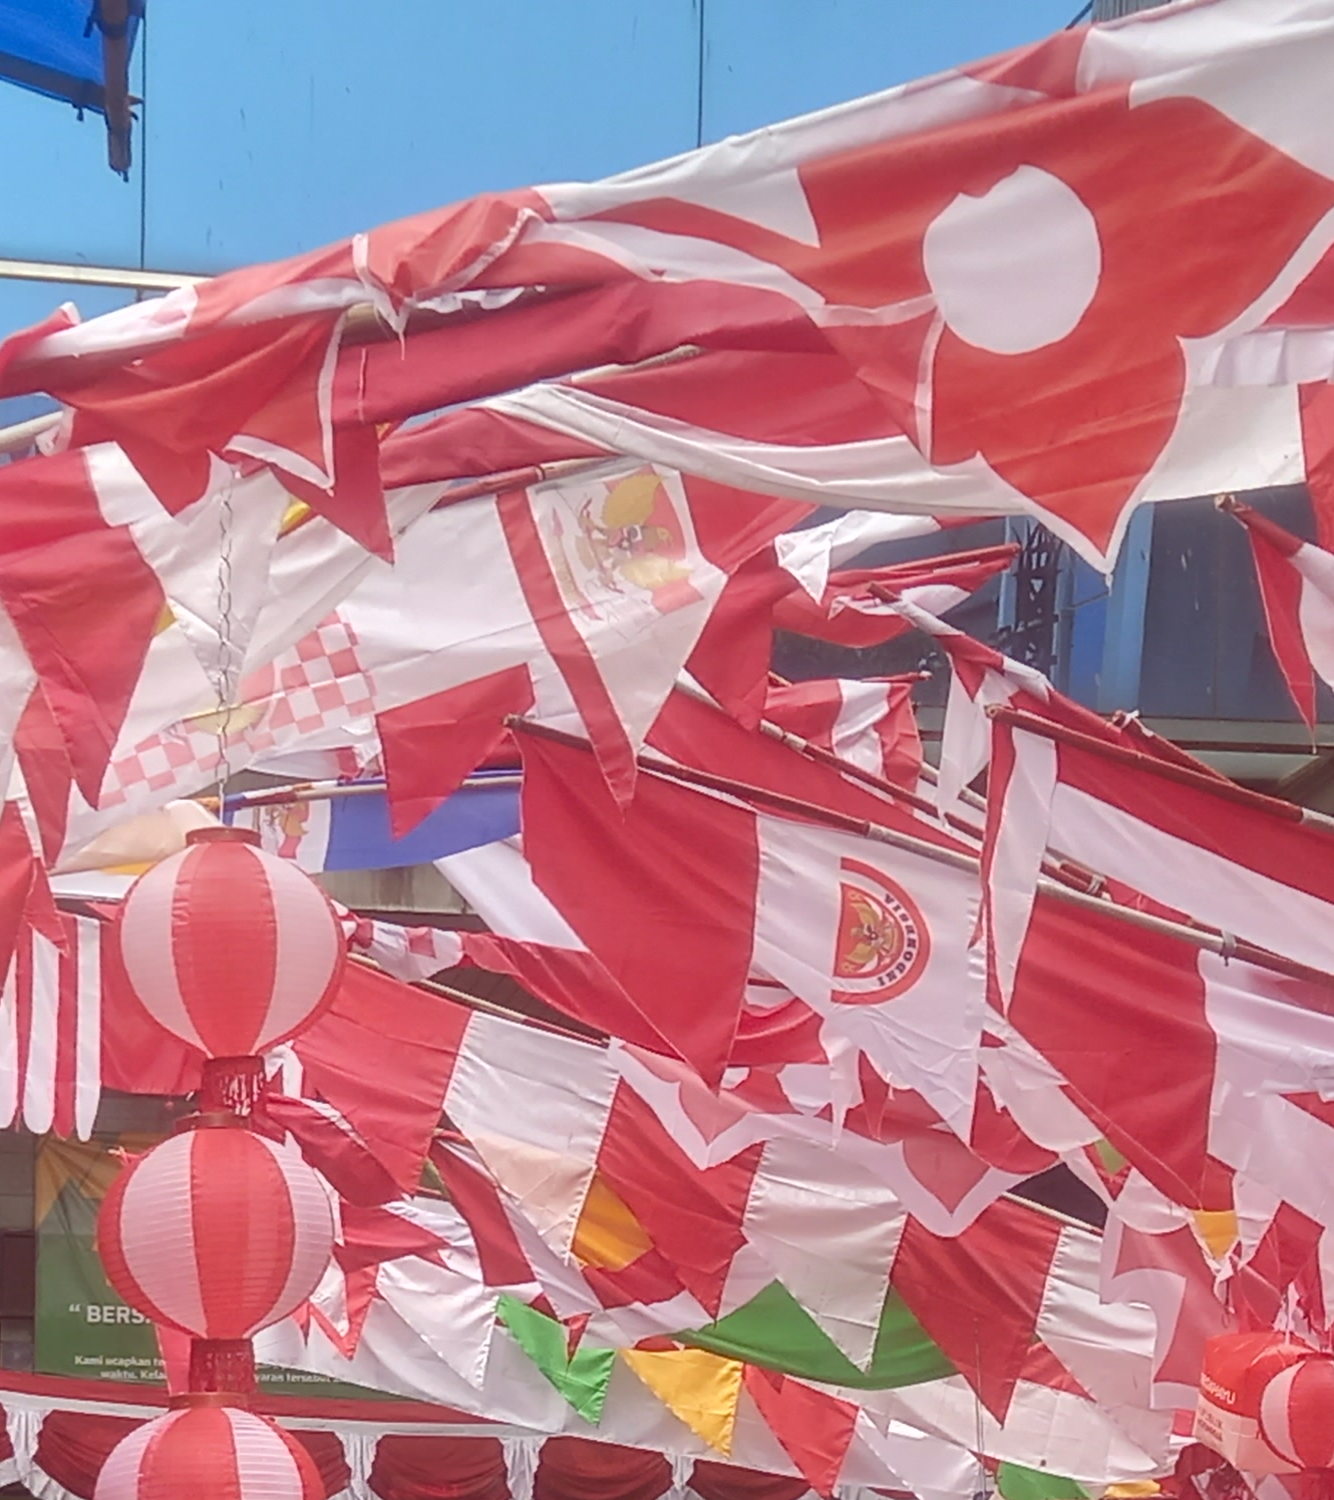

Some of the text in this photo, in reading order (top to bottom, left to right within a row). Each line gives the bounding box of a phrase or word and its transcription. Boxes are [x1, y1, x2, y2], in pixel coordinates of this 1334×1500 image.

[876, 892, 917, 987] INDONESIA
[86, 1304, 151, 1324] BERS
[74, 1354, 103, 1367] Kami
[105, 1355, 151, 1369] ucapkan
